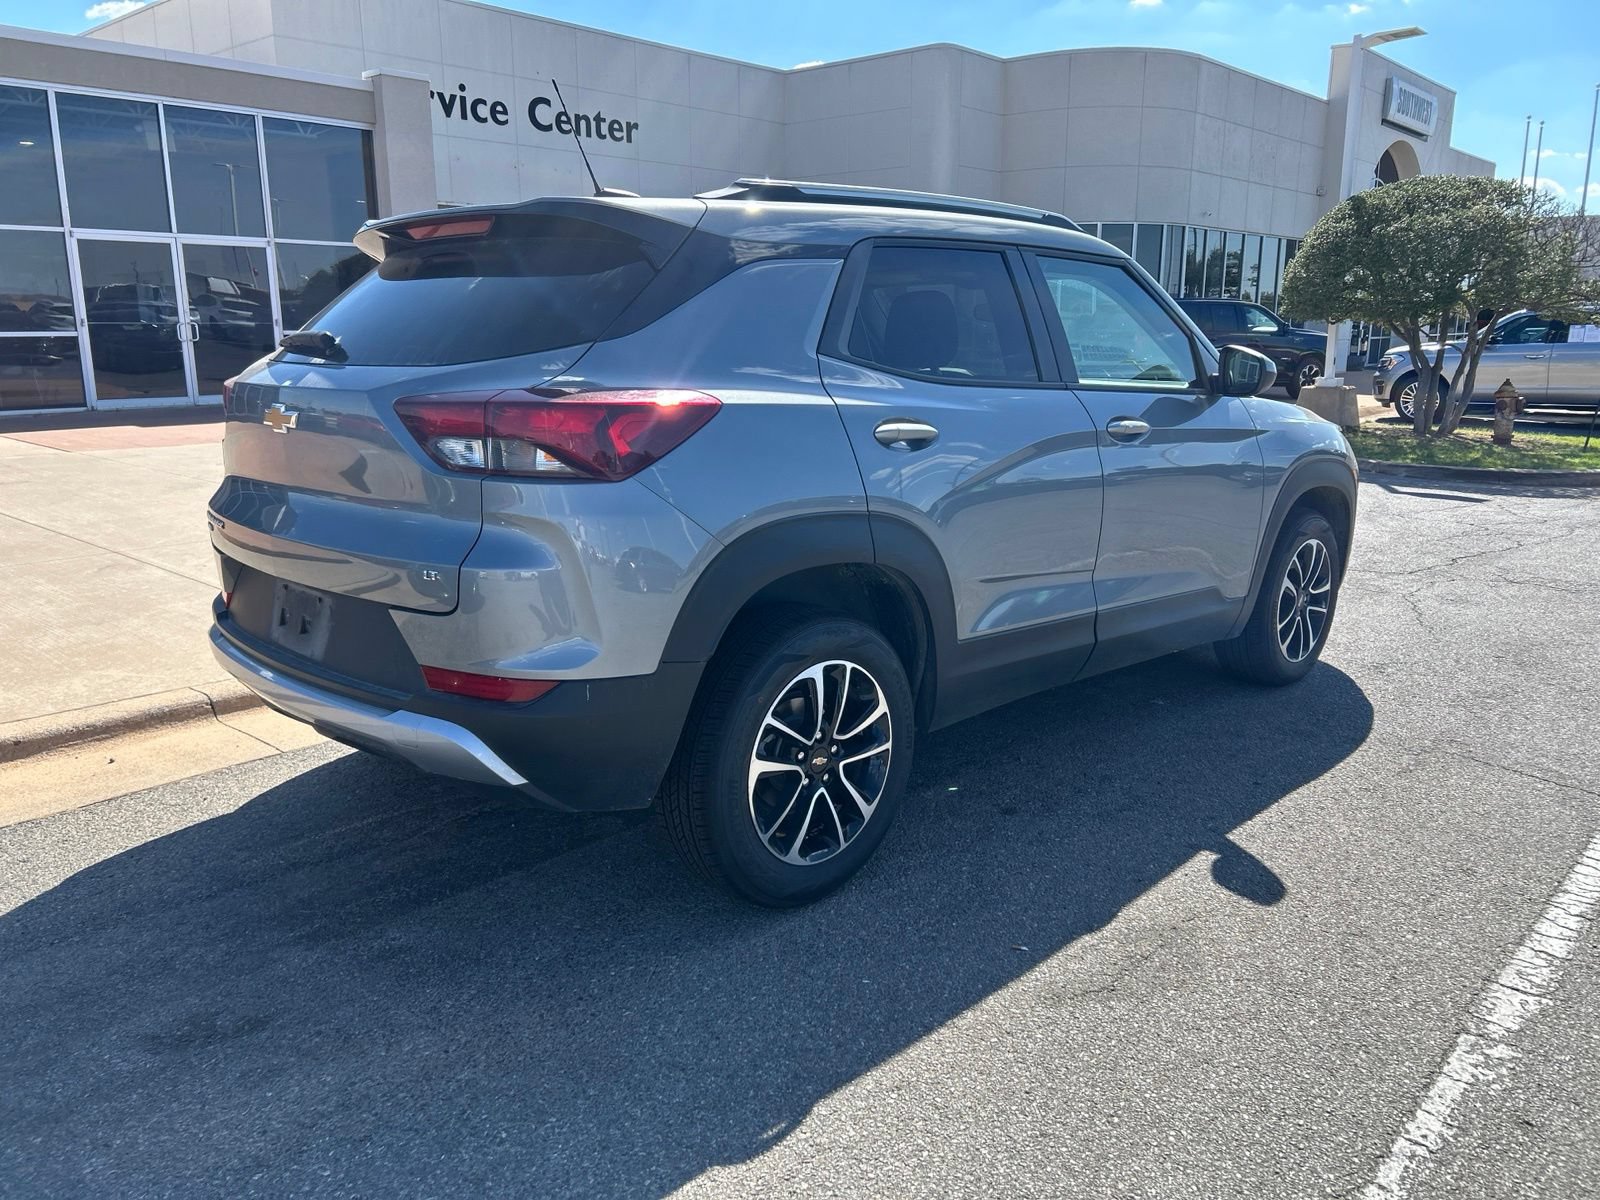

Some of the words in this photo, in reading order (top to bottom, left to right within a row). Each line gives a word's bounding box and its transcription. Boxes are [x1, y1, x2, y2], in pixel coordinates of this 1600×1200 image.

[430, 83, 509, 126] vice
[528, 97, 639, 143] Center
[1397, 87, 1433, 125] SOUTHWEST
[424, 570, 439, 581] LT
